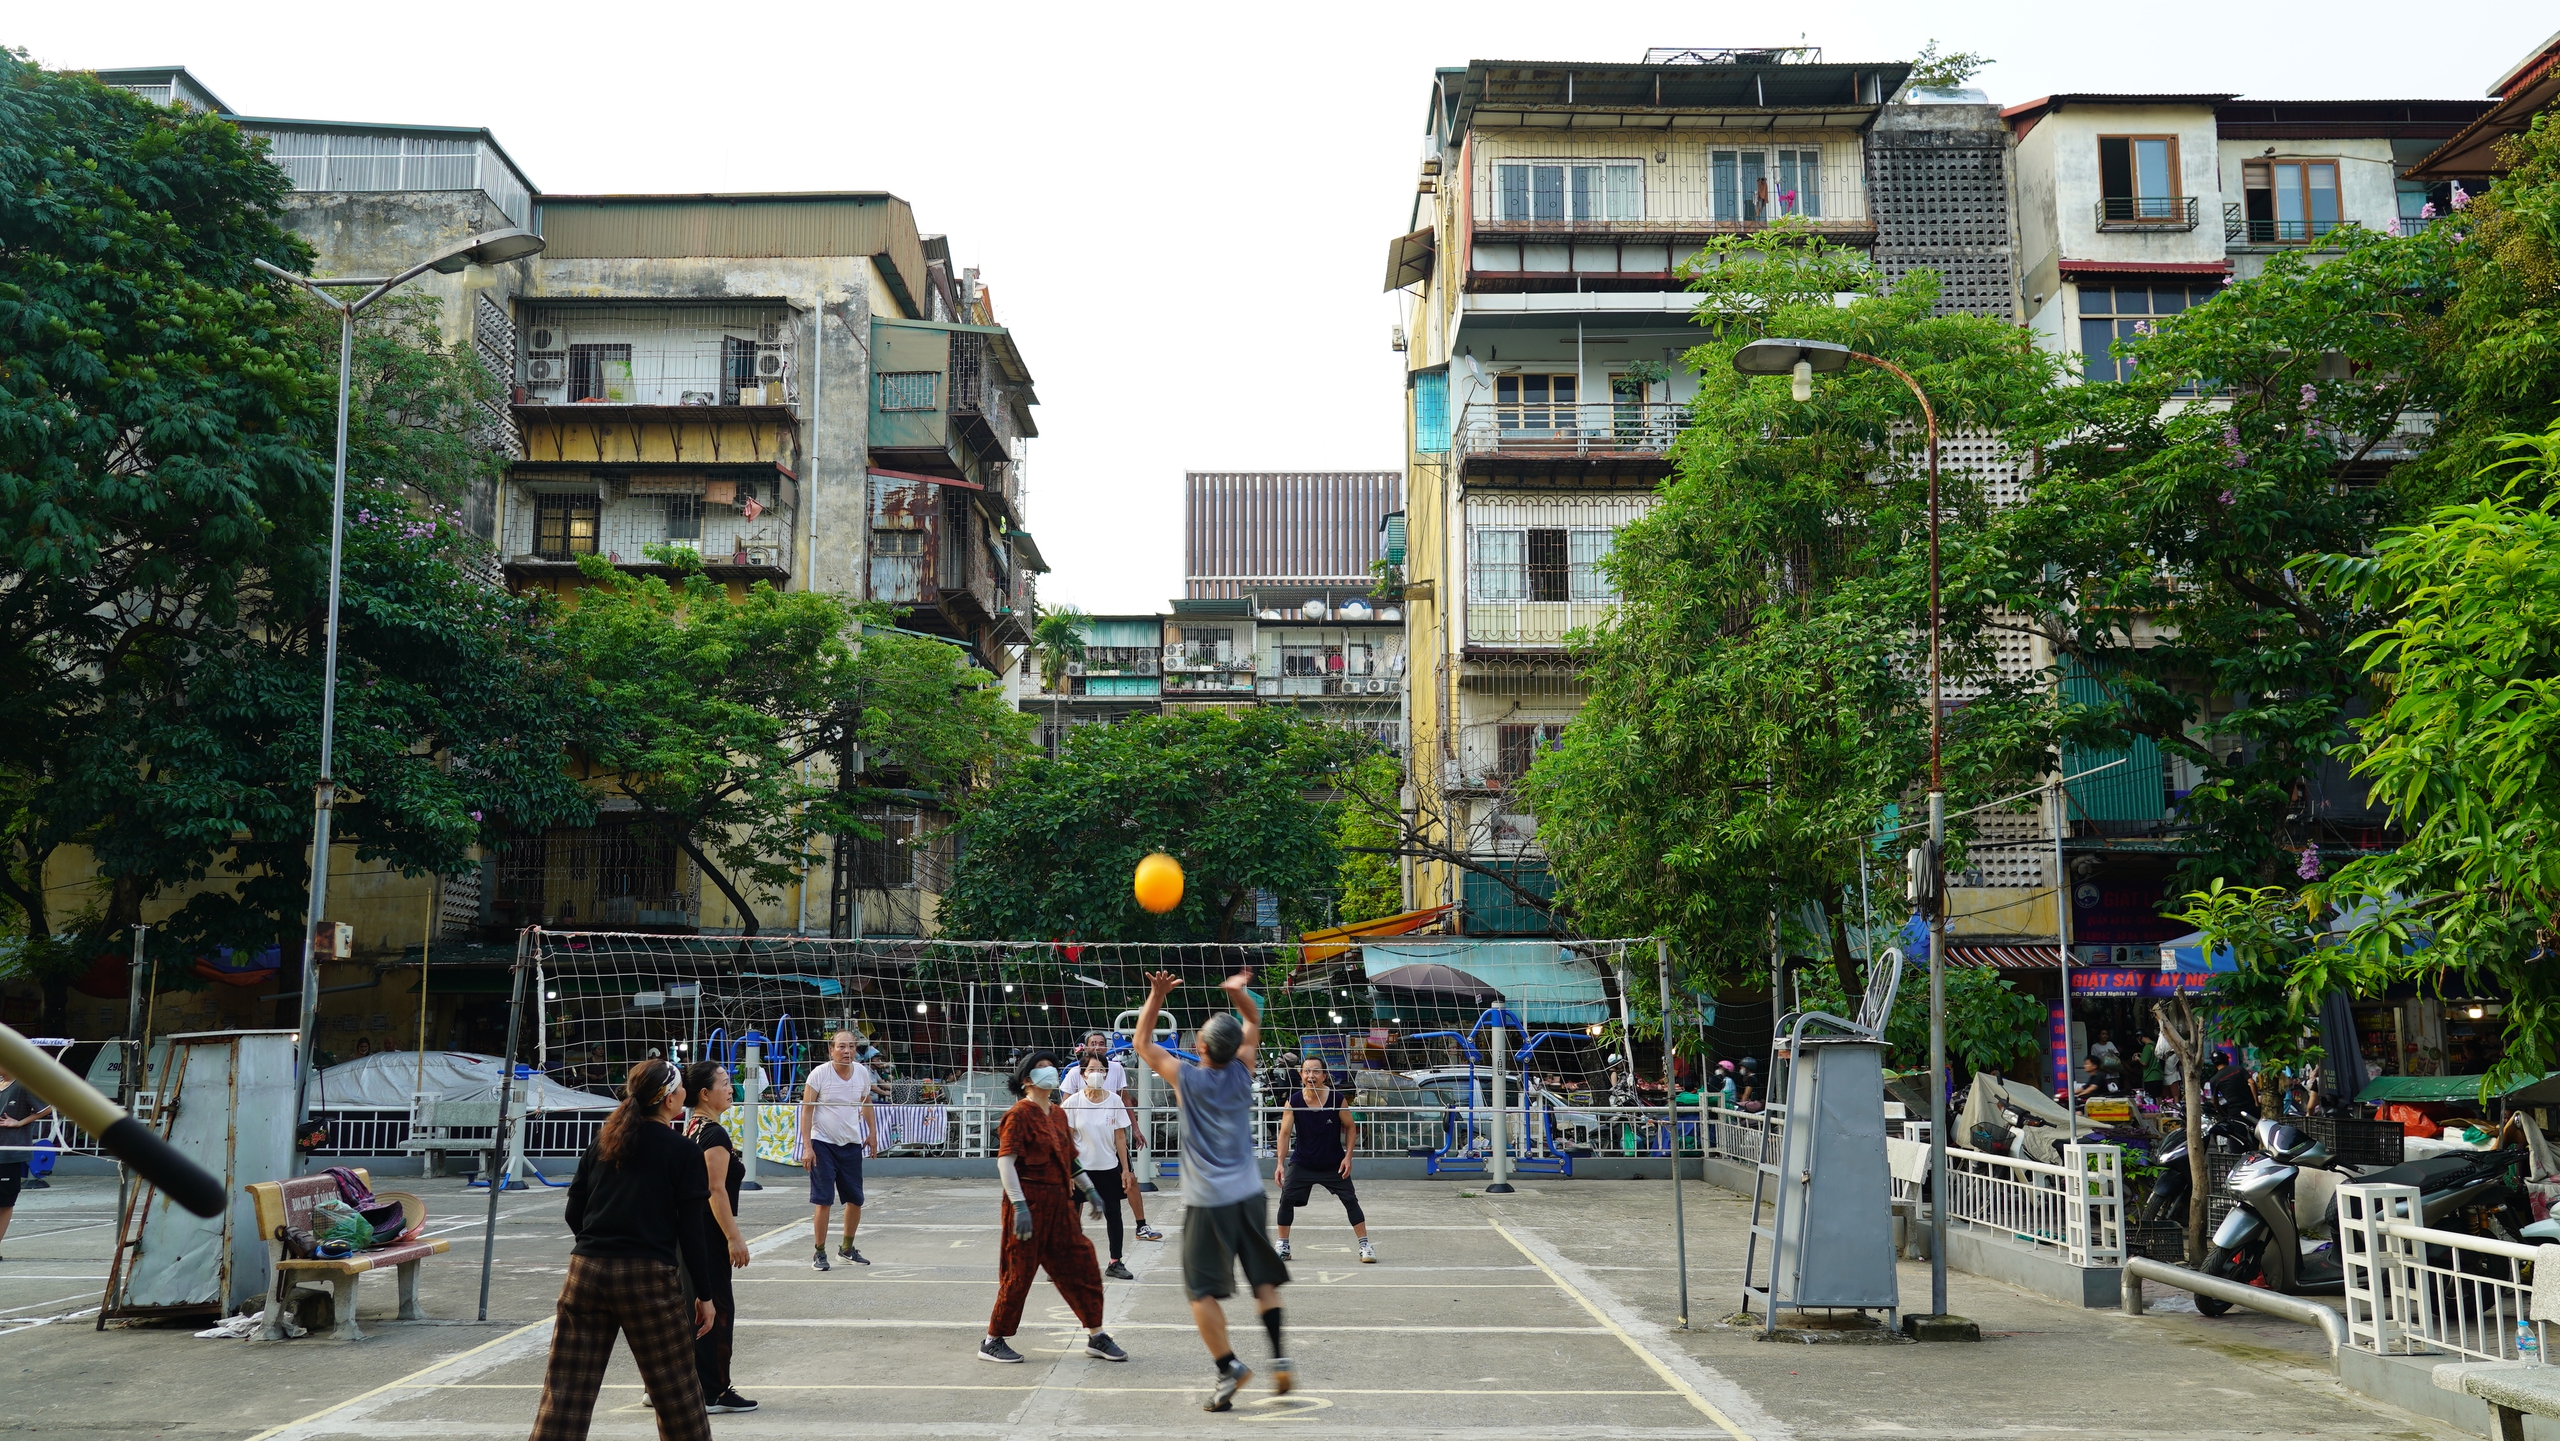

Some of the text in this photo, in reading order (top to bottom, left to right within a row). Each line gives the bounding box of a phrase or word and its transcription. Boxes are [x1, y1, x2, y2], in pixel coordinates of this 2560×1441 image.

[1970, 874, 1978, 884] 7
[2071, 972, 2109, 990] GIẶT
[2112, 970, 2146, 987] SẤY
[1238, 1396, 1334, 1422] 2
